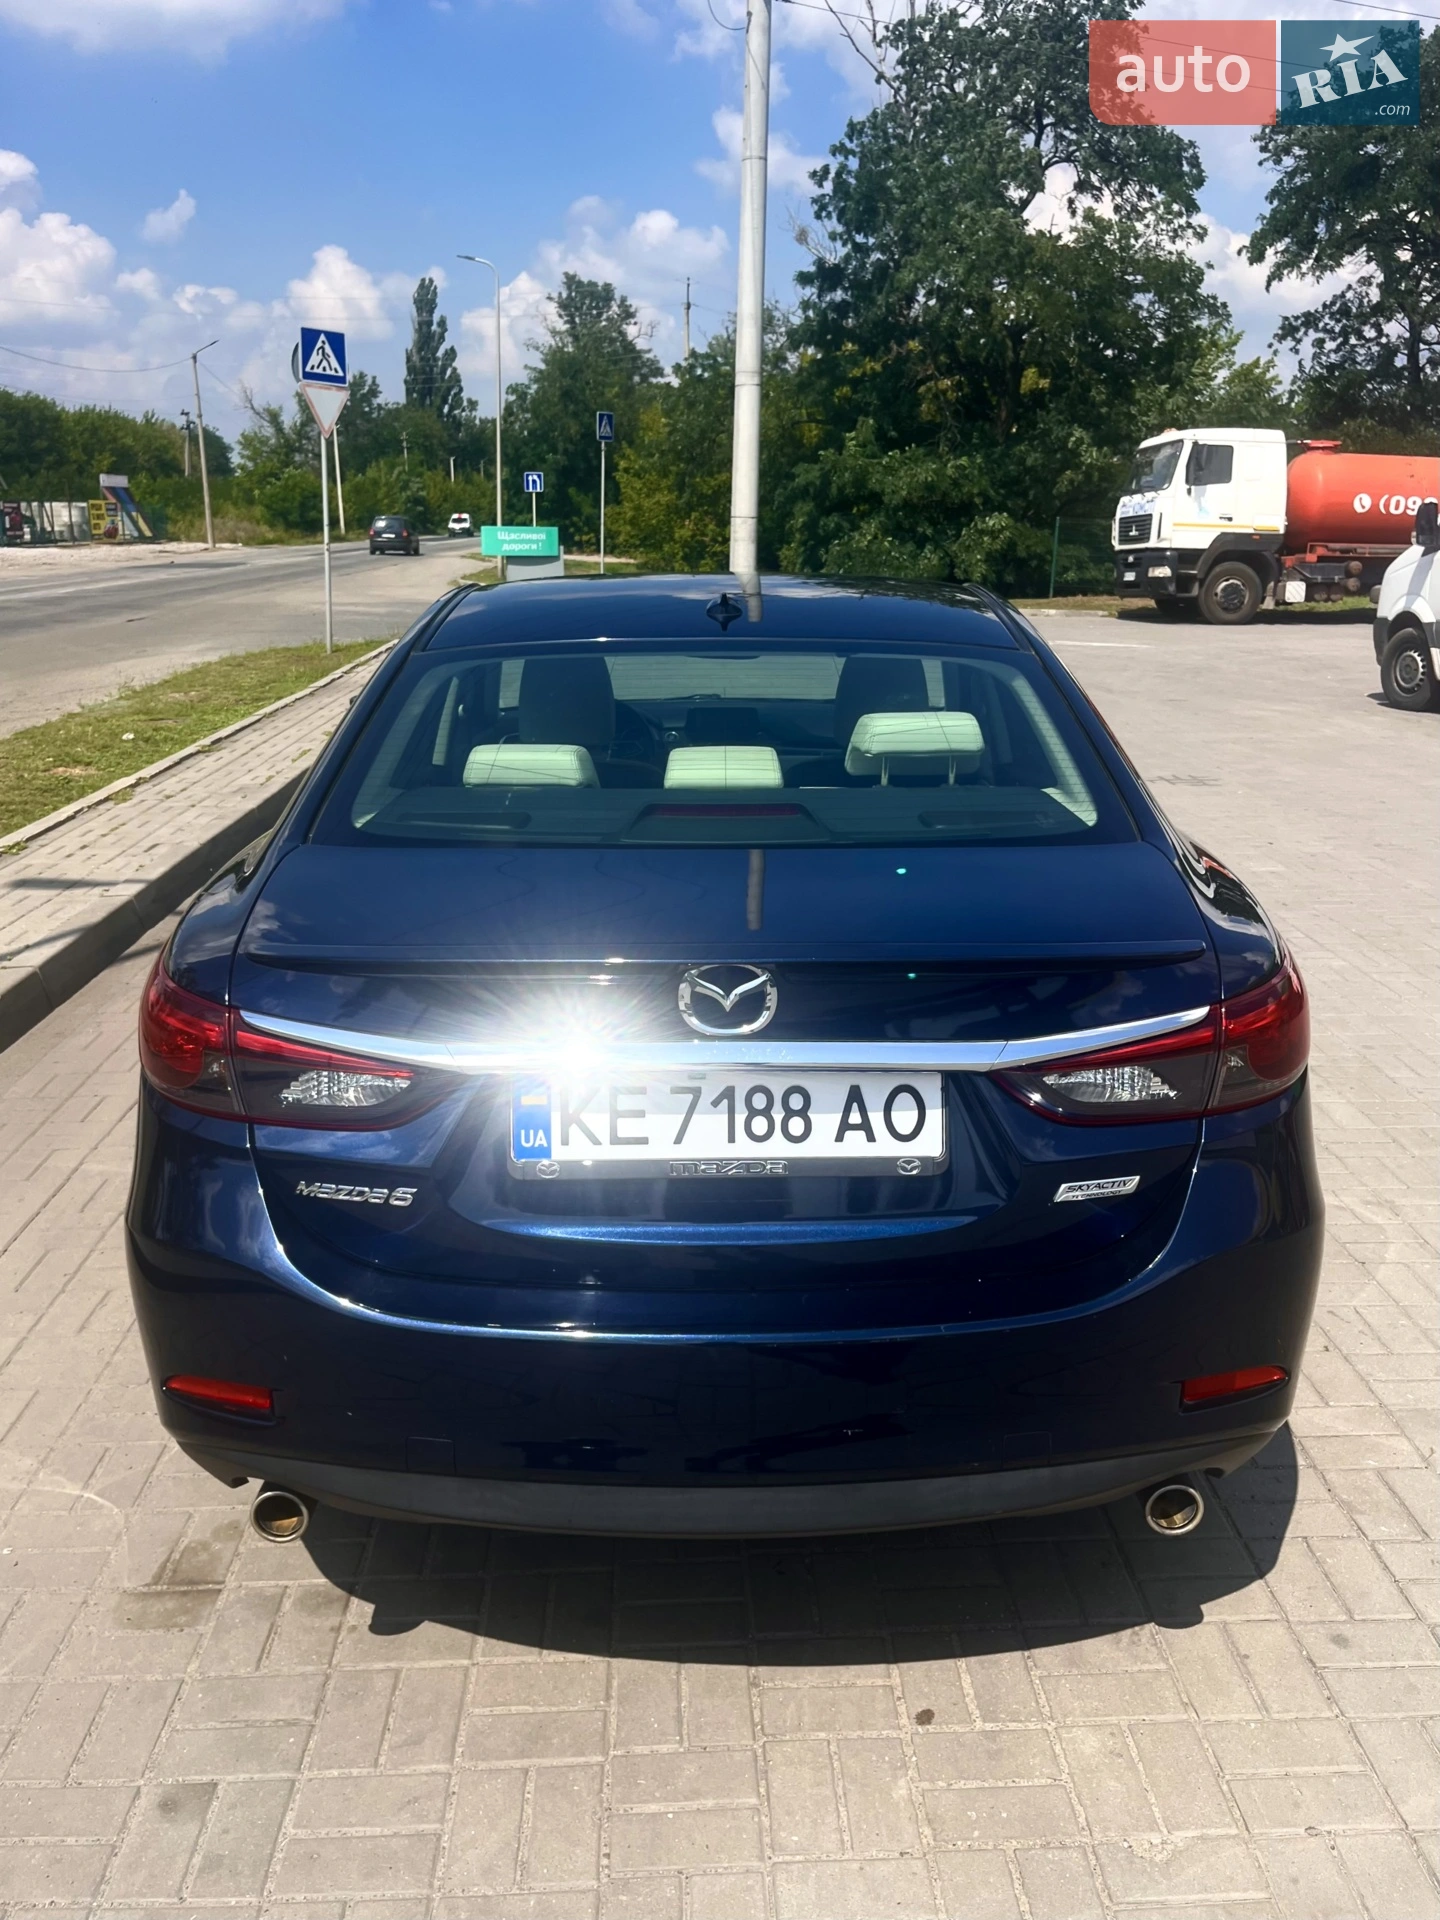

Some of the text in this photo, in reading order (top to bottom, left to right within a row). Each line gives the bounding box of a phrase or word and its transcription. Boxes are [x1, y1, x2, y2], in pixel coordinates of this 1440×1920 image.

[497, 531, 546, 541] Щасливої
[560, 1084, 927, 1146] KE 7188 AO
[520, 1129, 548, 1148] UA
[1066, 1179, 1133, 1193] SKYACTIV
